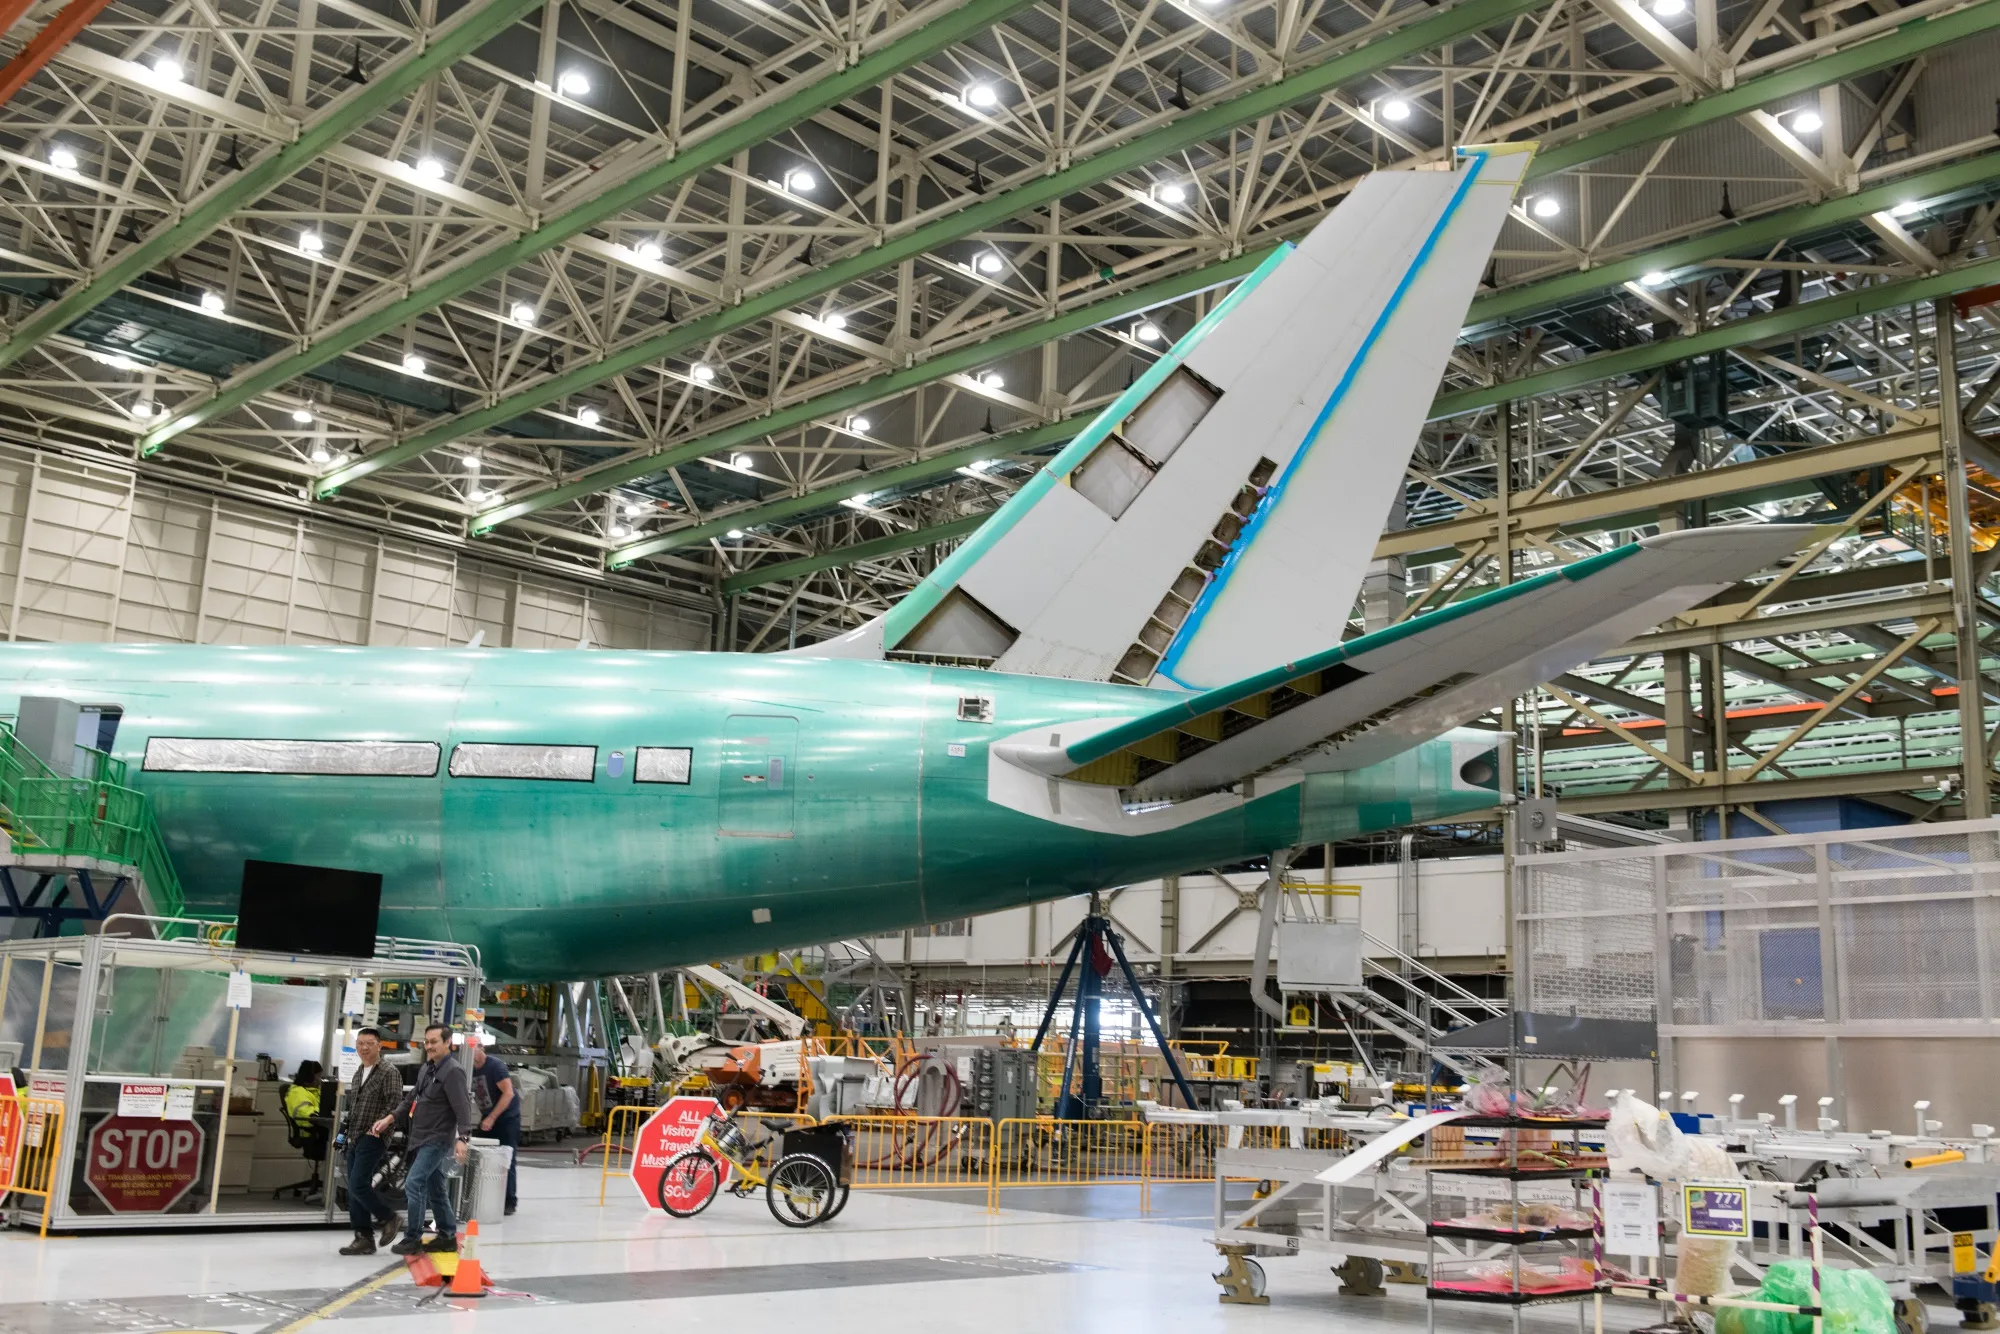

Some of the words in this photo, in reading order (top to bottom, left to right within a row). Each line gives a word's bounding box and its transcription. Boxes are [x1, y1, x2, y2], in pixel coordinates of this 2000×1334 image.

[134, 1086, 163, 1094] DANGER
[679, 1110, 701, 1121] ALL
[662, 1124, 699, 1137] Visitor
[98, 1128, 194, 1169] STOP
[1714, 1192, 1741, 1204] 777
